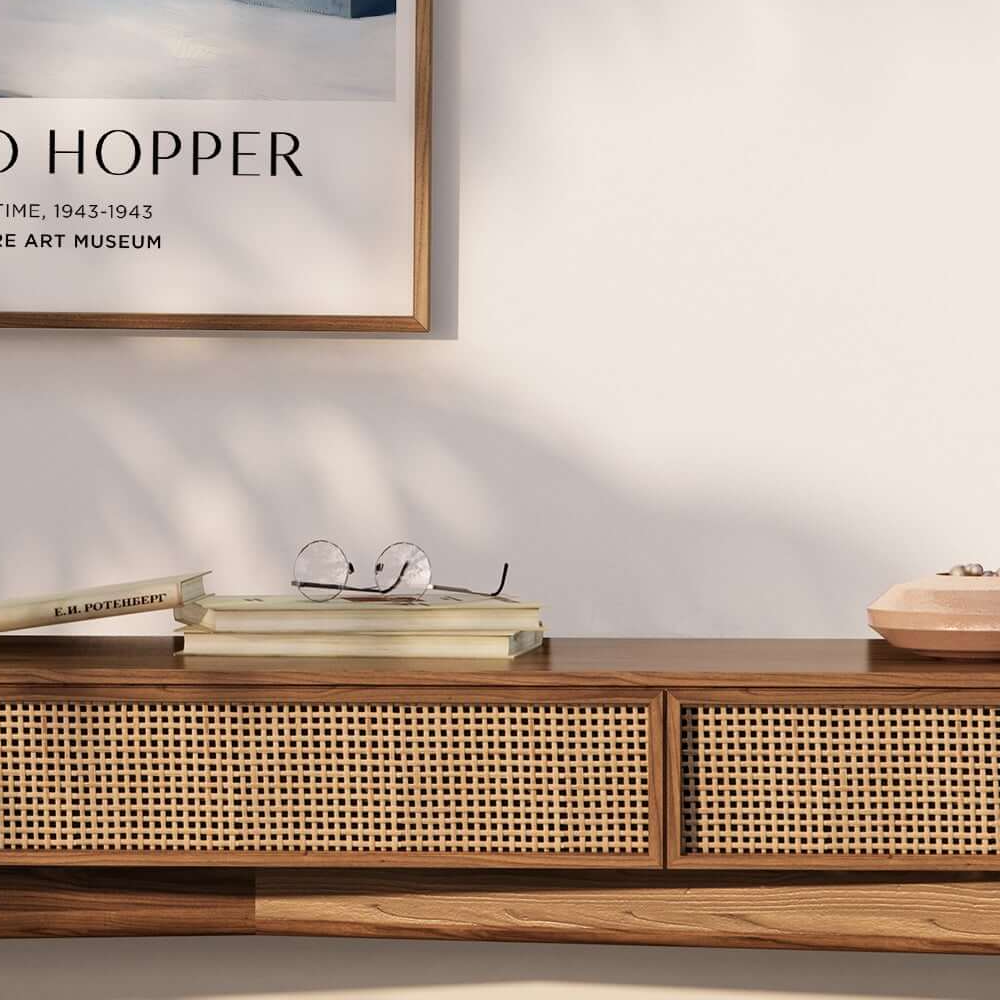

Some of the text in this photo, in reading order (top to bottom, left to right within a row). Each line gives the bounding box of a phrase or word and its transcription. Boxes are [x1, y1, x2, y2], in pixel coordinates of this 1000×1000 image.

[48, 129, 304, 177] HOPPER
[53, 204, 153, 219] 1943-1943
[23, 233, 67, 249] ART
[74, 234, 161, 250] MUSEUM
[84, 592, 168, 612] РОТЕНБЕРГ
